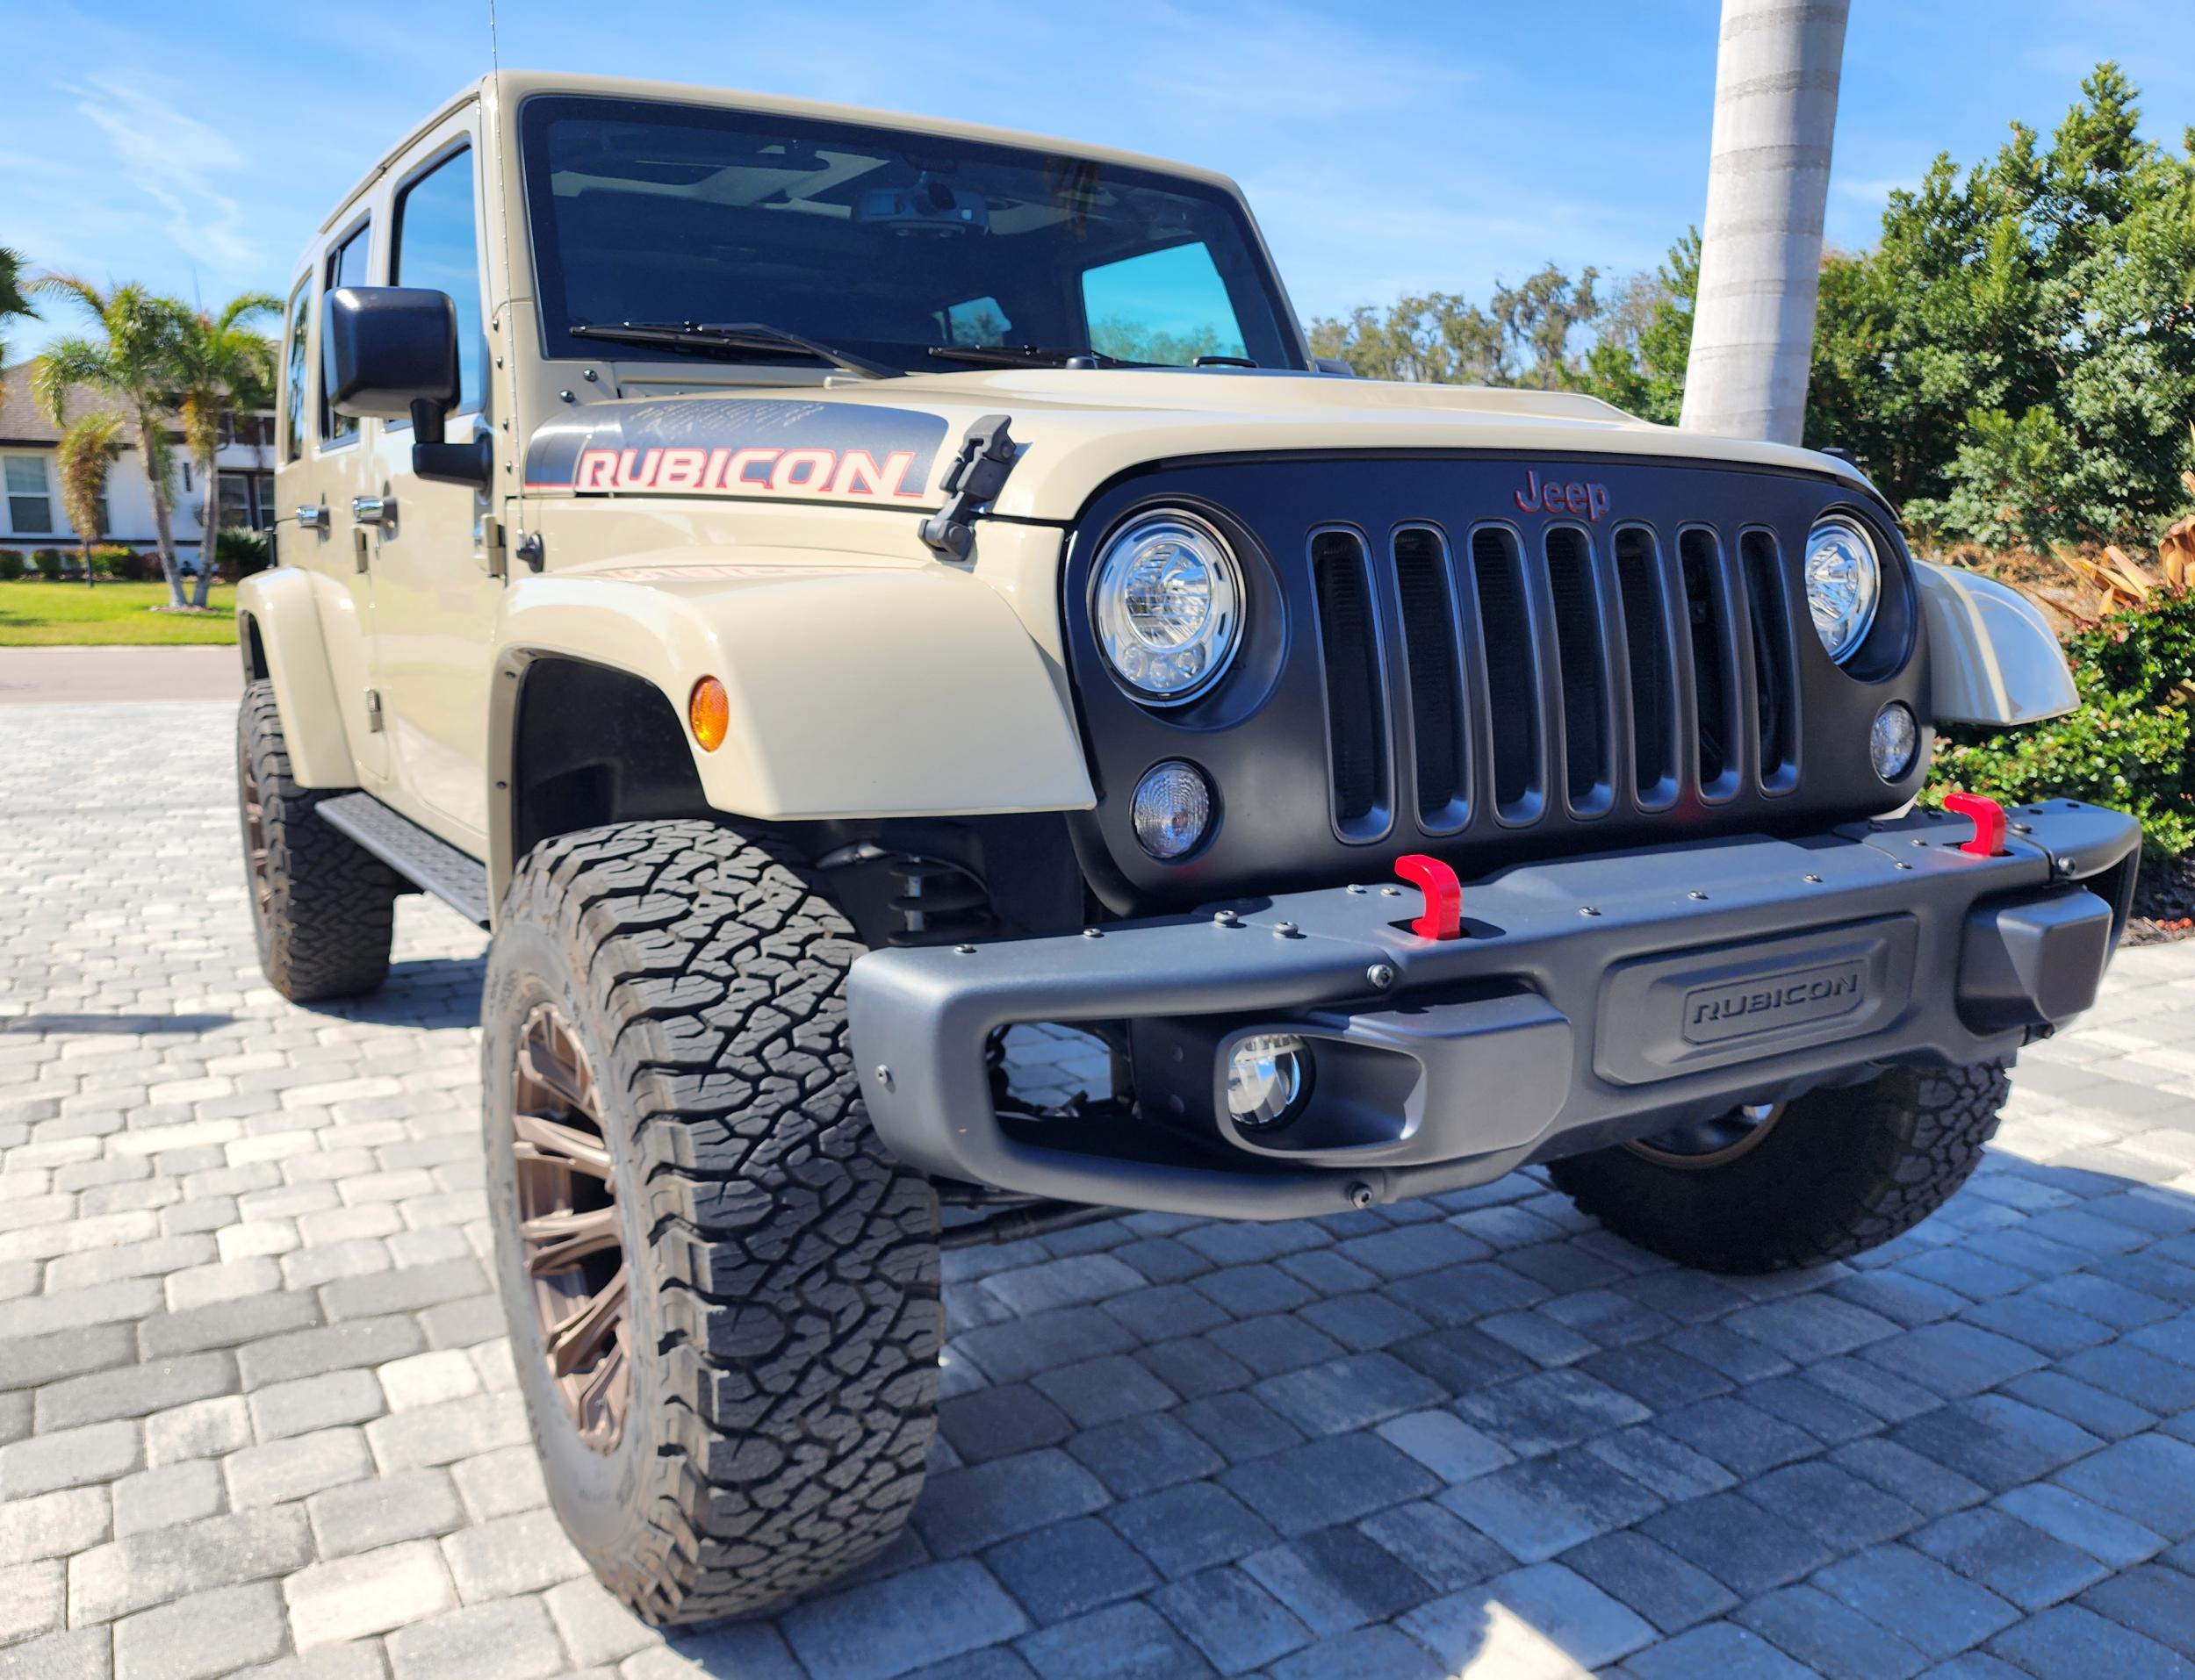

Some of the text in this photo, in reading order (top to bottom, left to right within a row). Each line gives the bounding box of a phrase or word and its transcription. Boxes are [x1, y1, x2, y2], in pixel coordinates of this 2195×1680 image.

[576, 448, 924, 498] RUBICON
[1515, 470, 1610, 522] Jeep
[1693, 974, 1858, 1023] RUBICON
